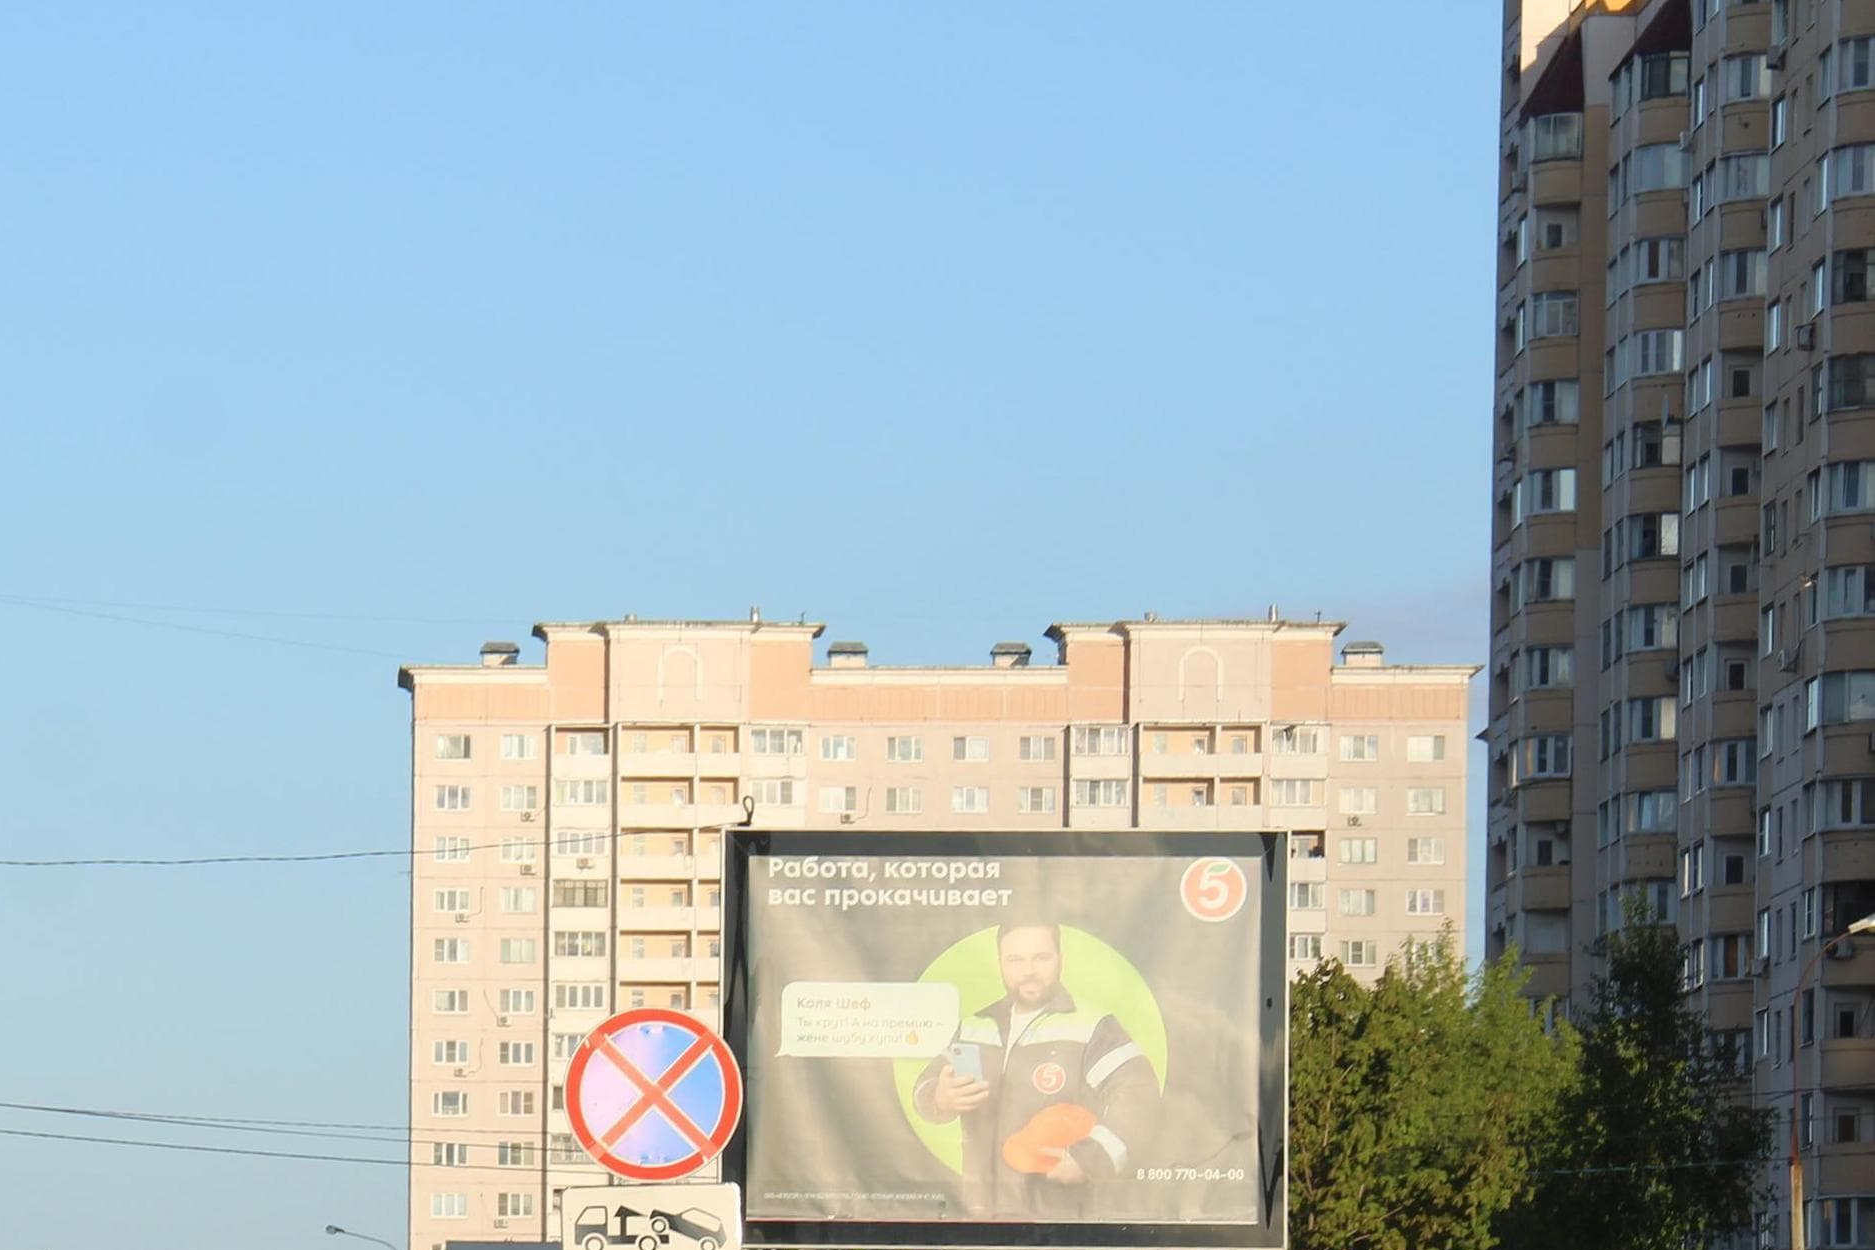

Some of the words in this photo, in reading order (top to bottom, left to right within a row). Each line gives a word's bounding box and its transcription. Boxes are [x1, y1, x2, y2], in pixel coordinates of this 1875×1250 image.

[769, 857, 876, 882] Работа,
[884, 861, 1000, 884] которая
[768, 888, 816, 906] вас
[824, 888, 1013, 910] прокачивает
[796, 997, 831, 1009] Коля
[836, 997, 871, 1011] Шеф
[1136, 1168, 1145, 1180] 8
[1147, 1168, 1172, 1180] 800
